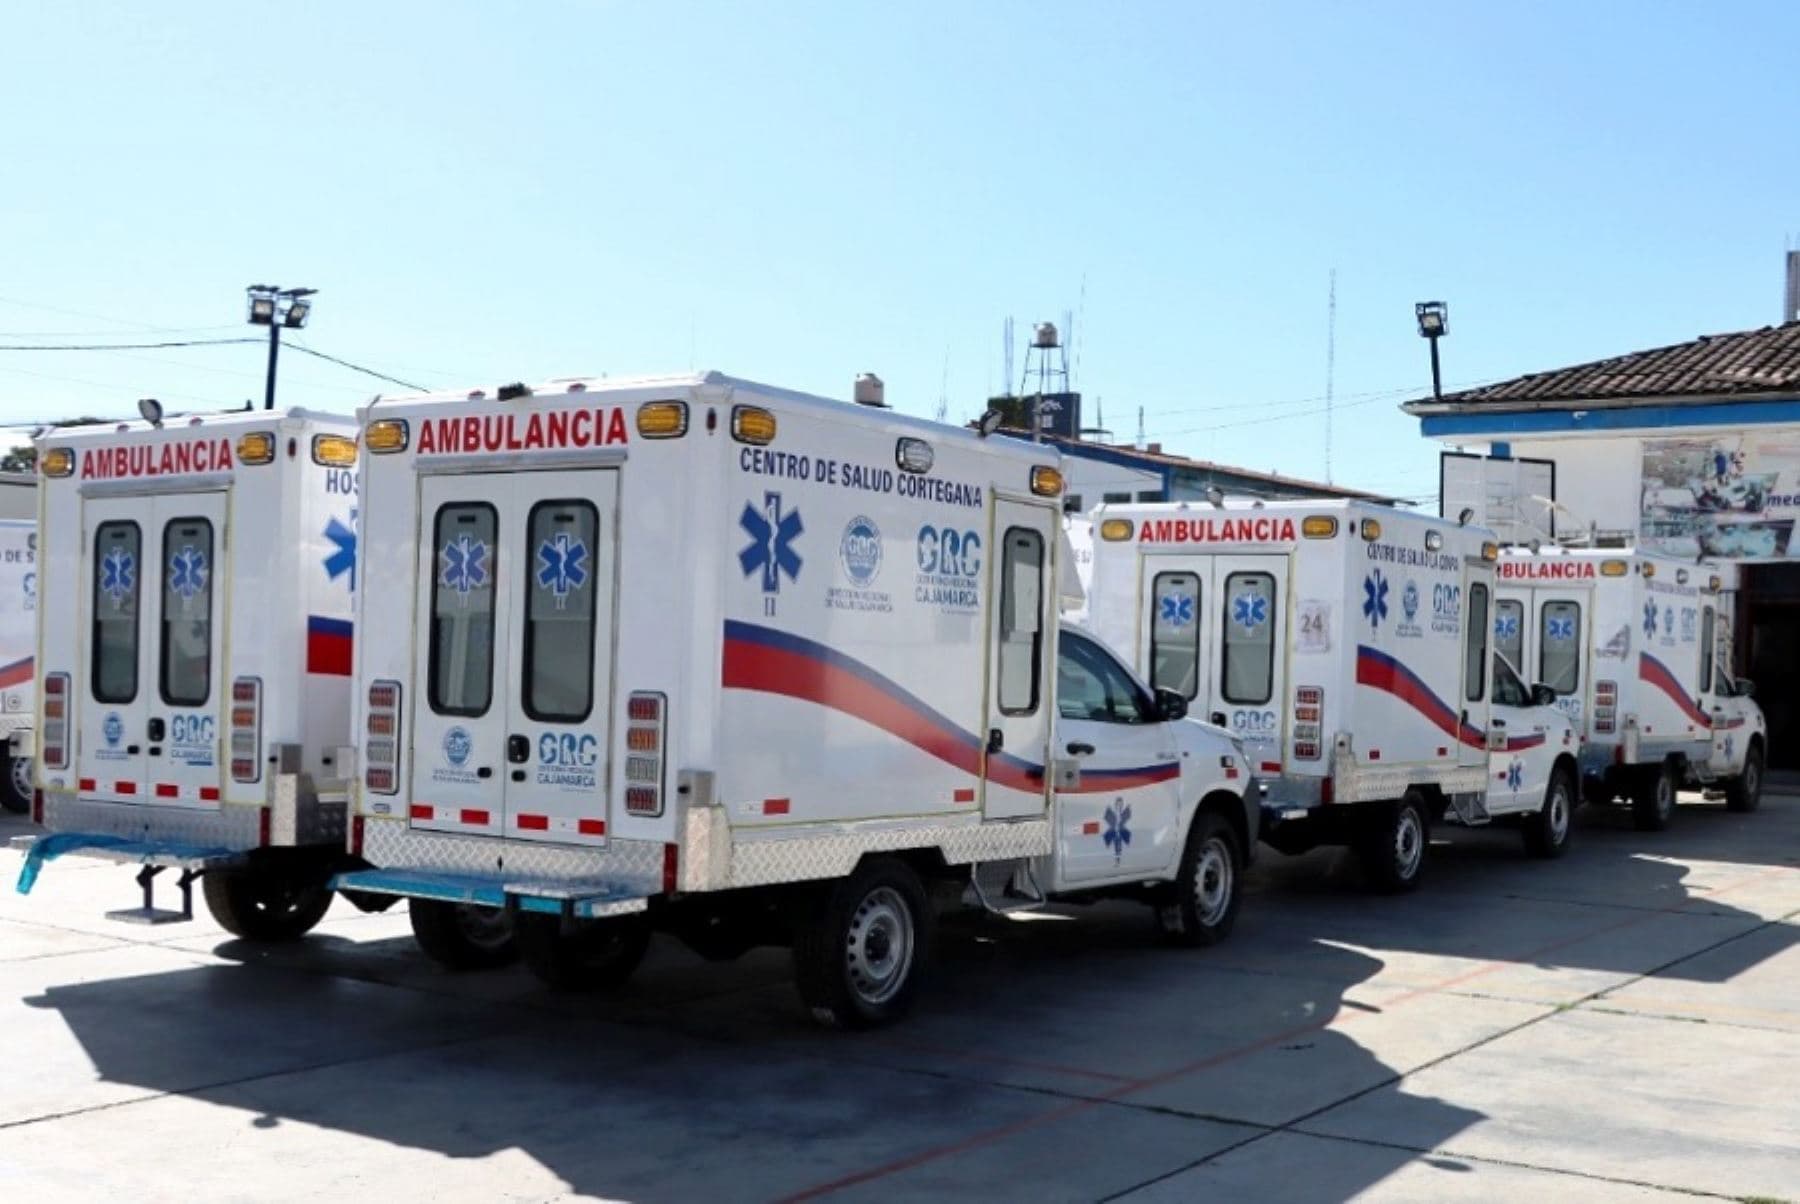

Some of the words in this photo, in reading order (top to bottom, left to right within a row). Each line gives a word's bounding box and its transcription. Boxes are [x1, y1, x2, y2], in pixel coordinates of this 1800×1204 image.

[417, 406, 628, 454] AMBULANCIA
[81, 438, 233, 480] AMBULANCIA
[740, 447, 810, 481] CENTRO
[815, 459, 836, 484] DE
[841, 463, 893, 493] SALUD
[897, 473, 983, 508] CORTEGANA
[1139, 518, 1296, 543] AMBULANCIA
[917, 525, 981, 577] GRC
[1367, 543, 1395, 562] CENTRO
[1497, 562, 1595, 579] BULANCIA
[915, 587, 979, 607] CAJAMARCA
[1301, 613, 1322, 633] 24
[172, 714, 214, 742] GRC
[1233, 710, 1275, 730] GRC
[539, 732, 597, 766] GRC
[536, 773, 596, 787] CAJAMARCA
